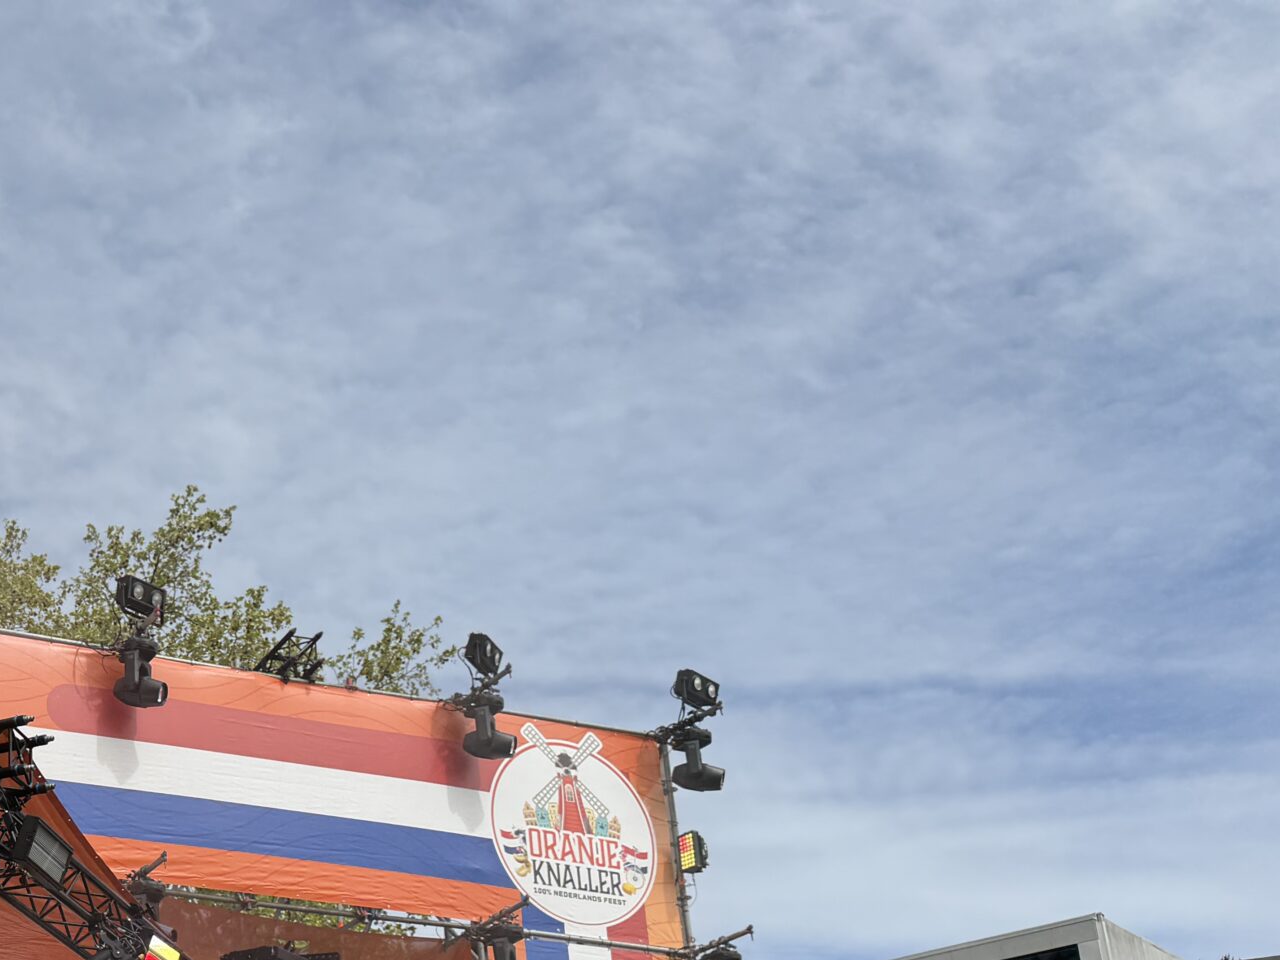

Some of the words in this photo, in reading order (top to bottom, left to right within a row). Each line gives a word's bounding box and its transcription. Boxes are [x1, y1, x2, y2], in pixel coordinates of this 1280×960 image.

[528, 828, 621, 870] ORANJE
[532, 859, 624, 897] KNALLER
[533, 887, 552, 896] 100%
[554, 890, 602, 903] NEDERLANDS
[604, 897, 627, 906] FEEST
